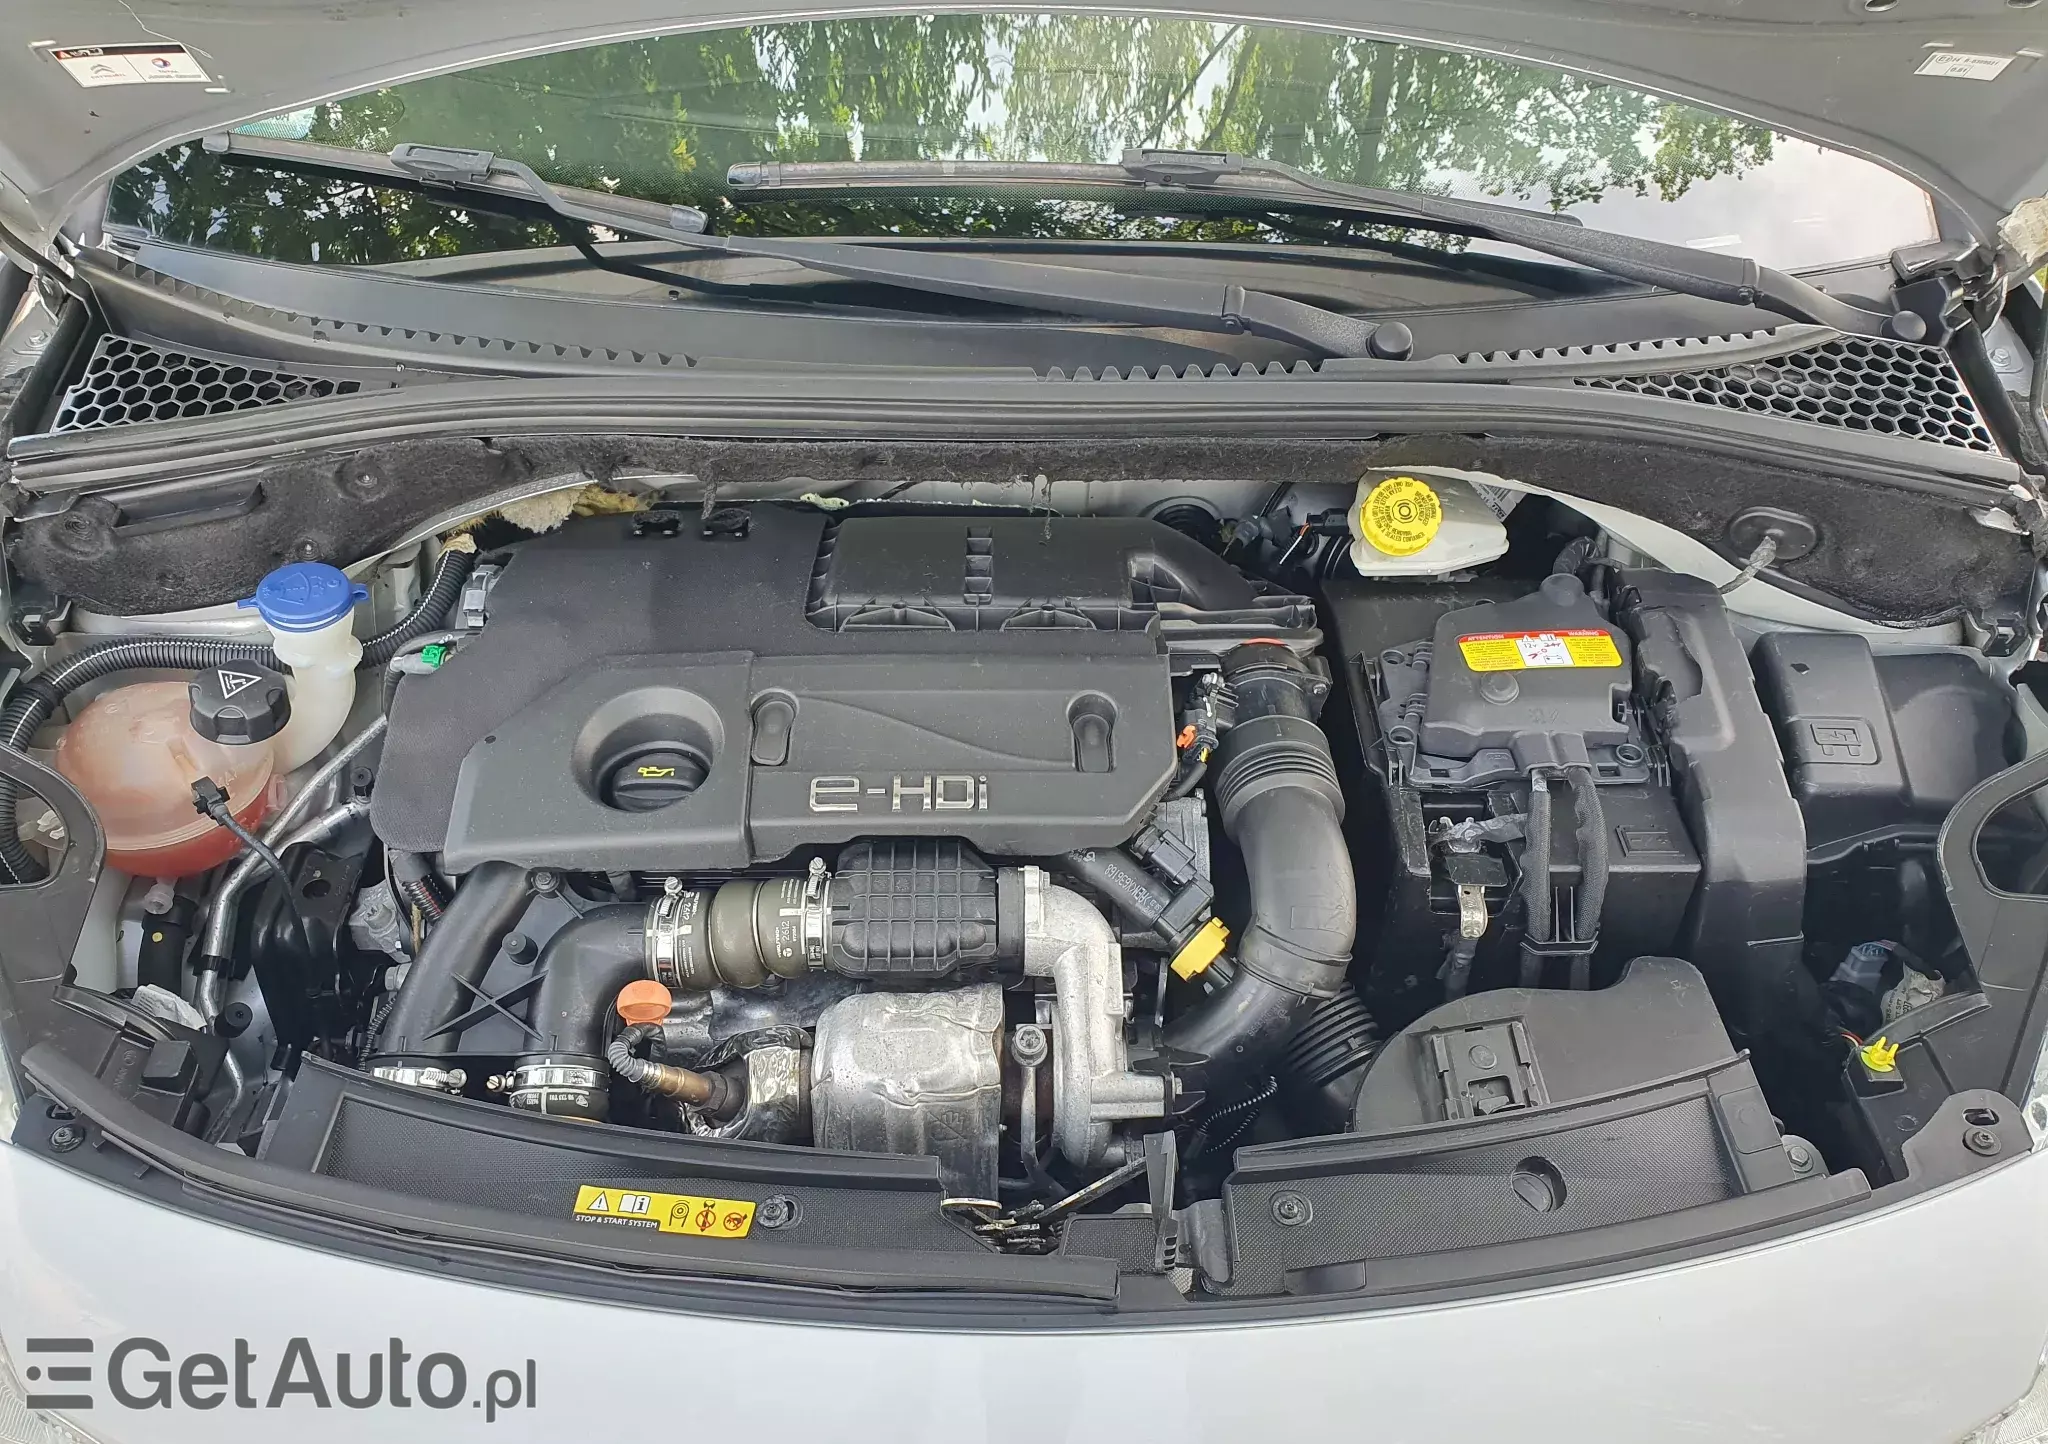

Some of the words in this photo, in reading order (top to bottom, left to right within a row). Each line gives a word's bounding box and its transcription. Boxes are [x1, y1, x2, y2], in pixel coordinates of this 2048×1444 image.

[575, 1214, 596, 1223] STOP
[602, 1217, 628, 1226] START
[628, 1219, 658, 1229] SYSTEM
